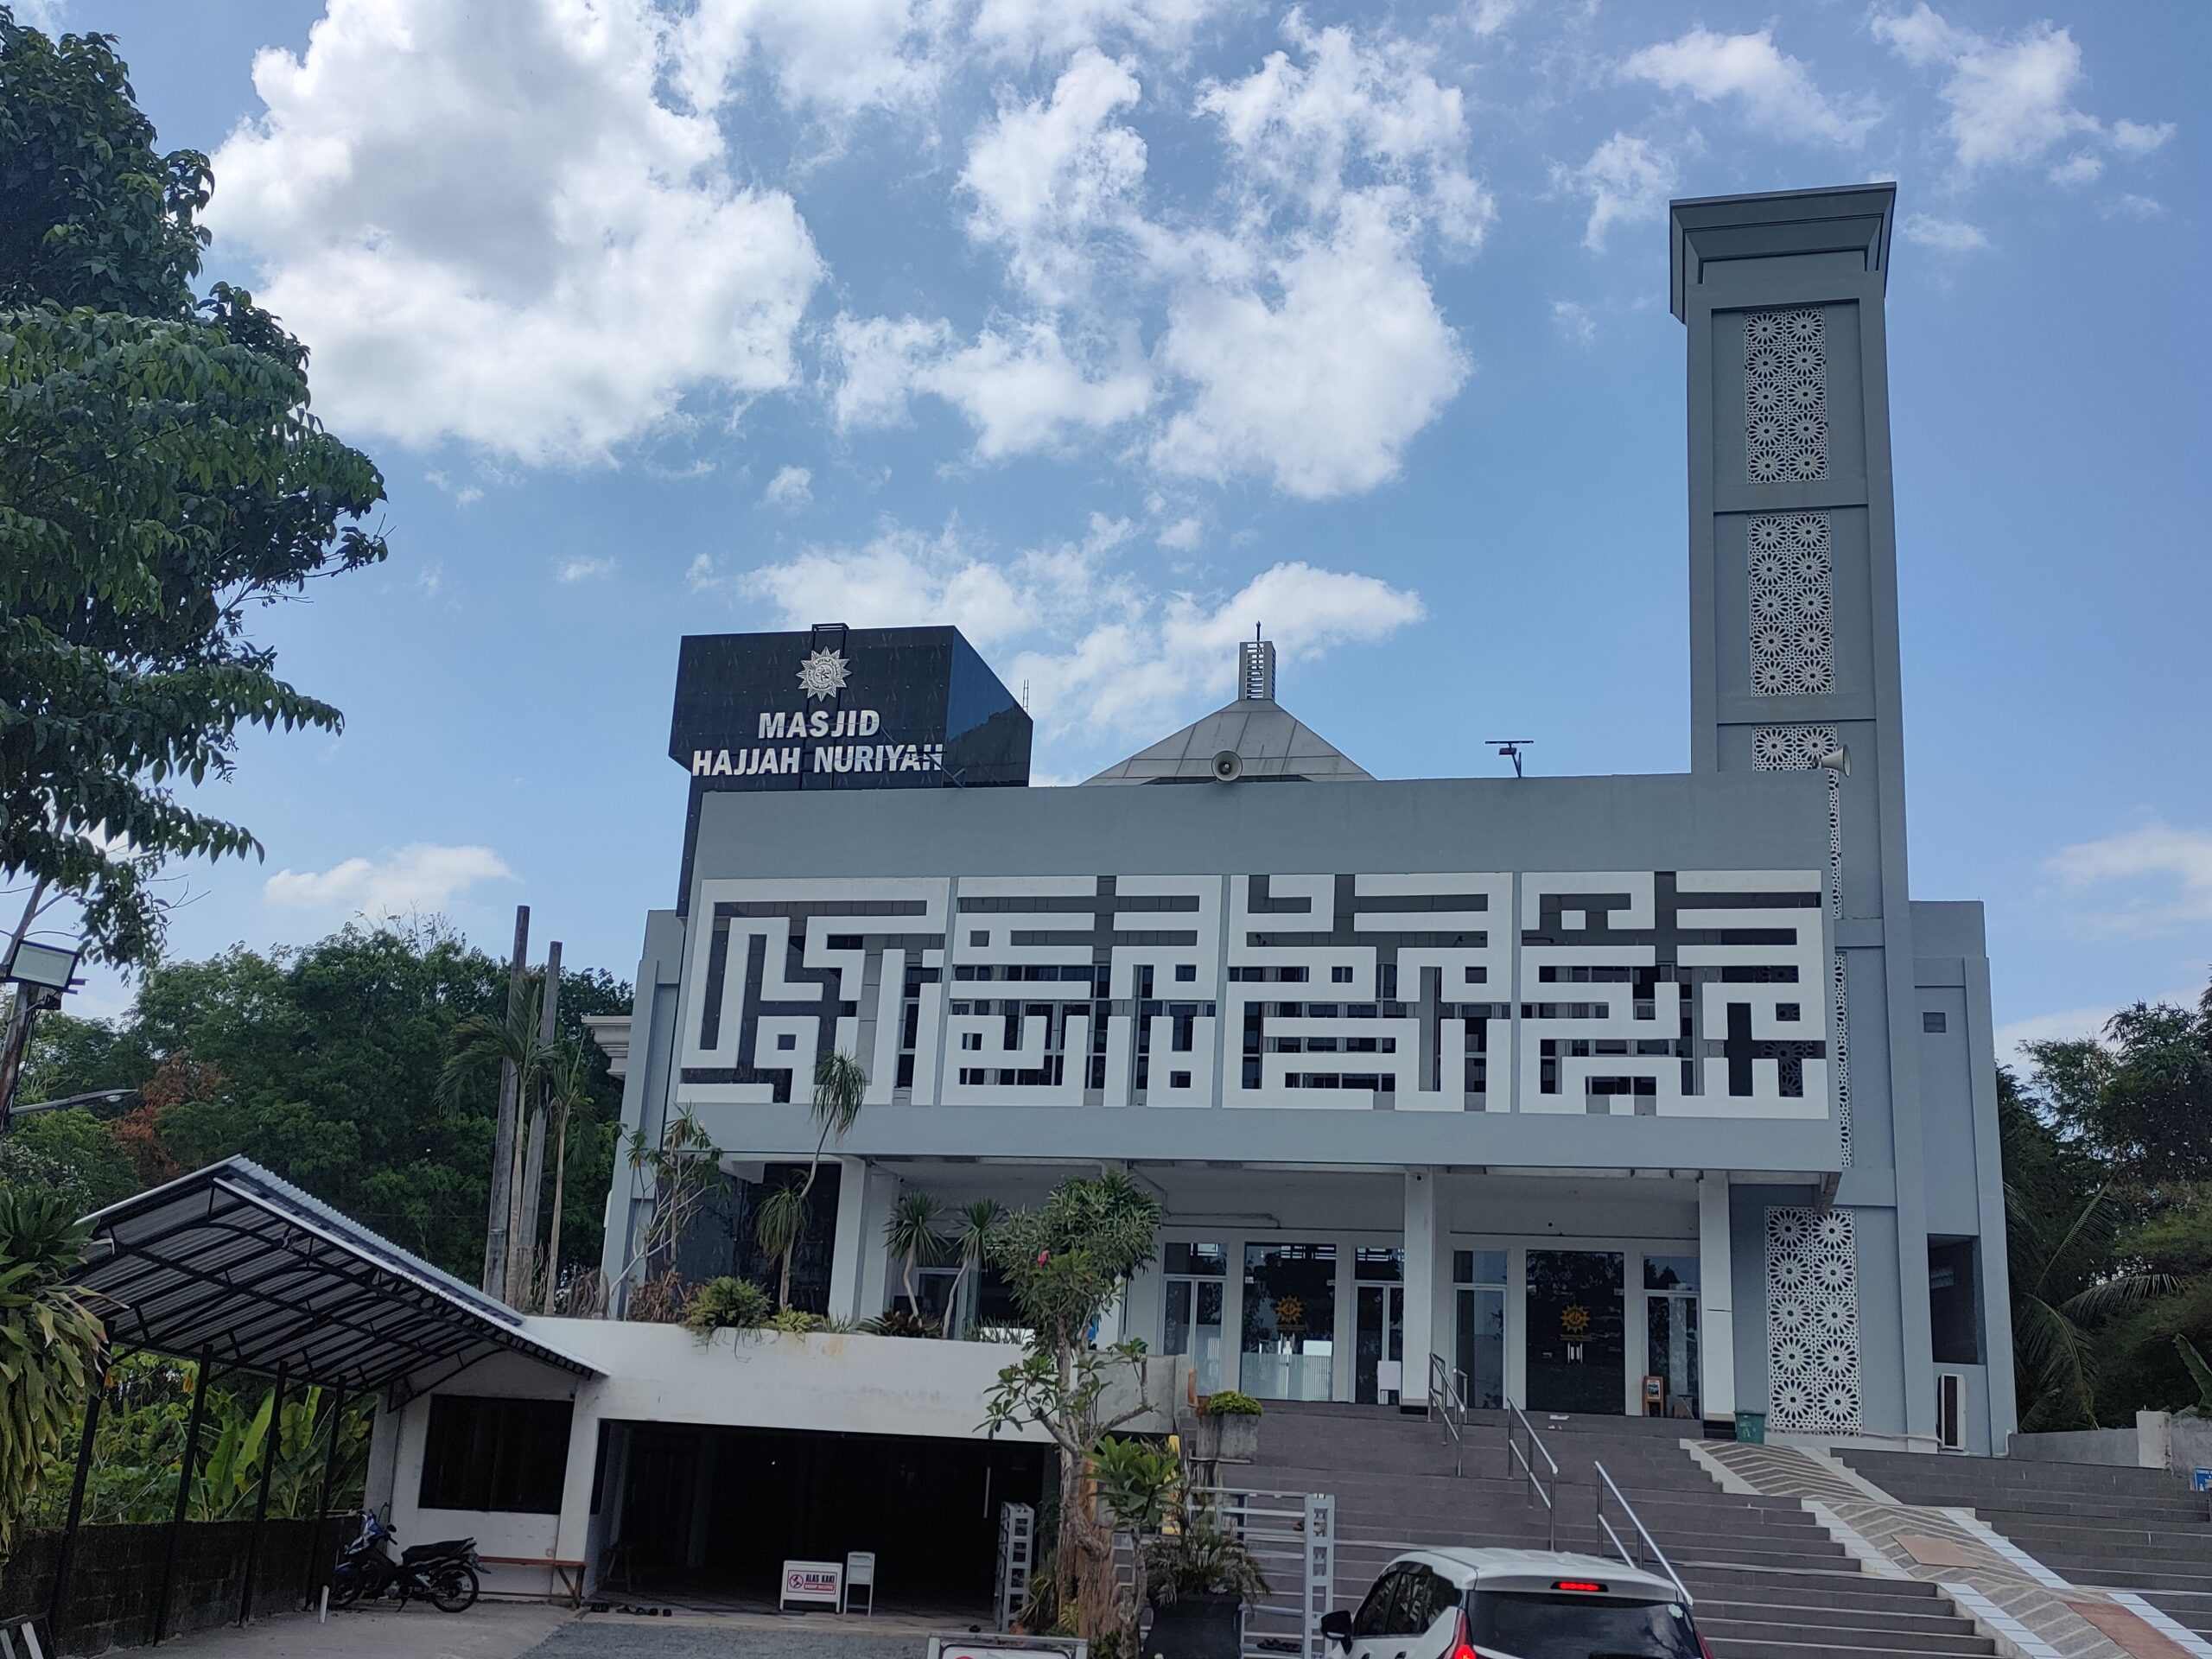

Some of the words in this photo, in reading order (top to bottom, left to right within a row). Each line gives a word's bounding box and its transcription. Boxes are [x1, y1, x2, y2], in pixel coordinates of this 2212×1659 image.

[758, 709, 881, 739] MASJID
[692, 747, 801, 778] HAJJAH
[813, 743, 944, 773] NURIYAH
[805, 1573, 819, 1583] ALAS
[822, 1575, 836, 1584] KAKI
